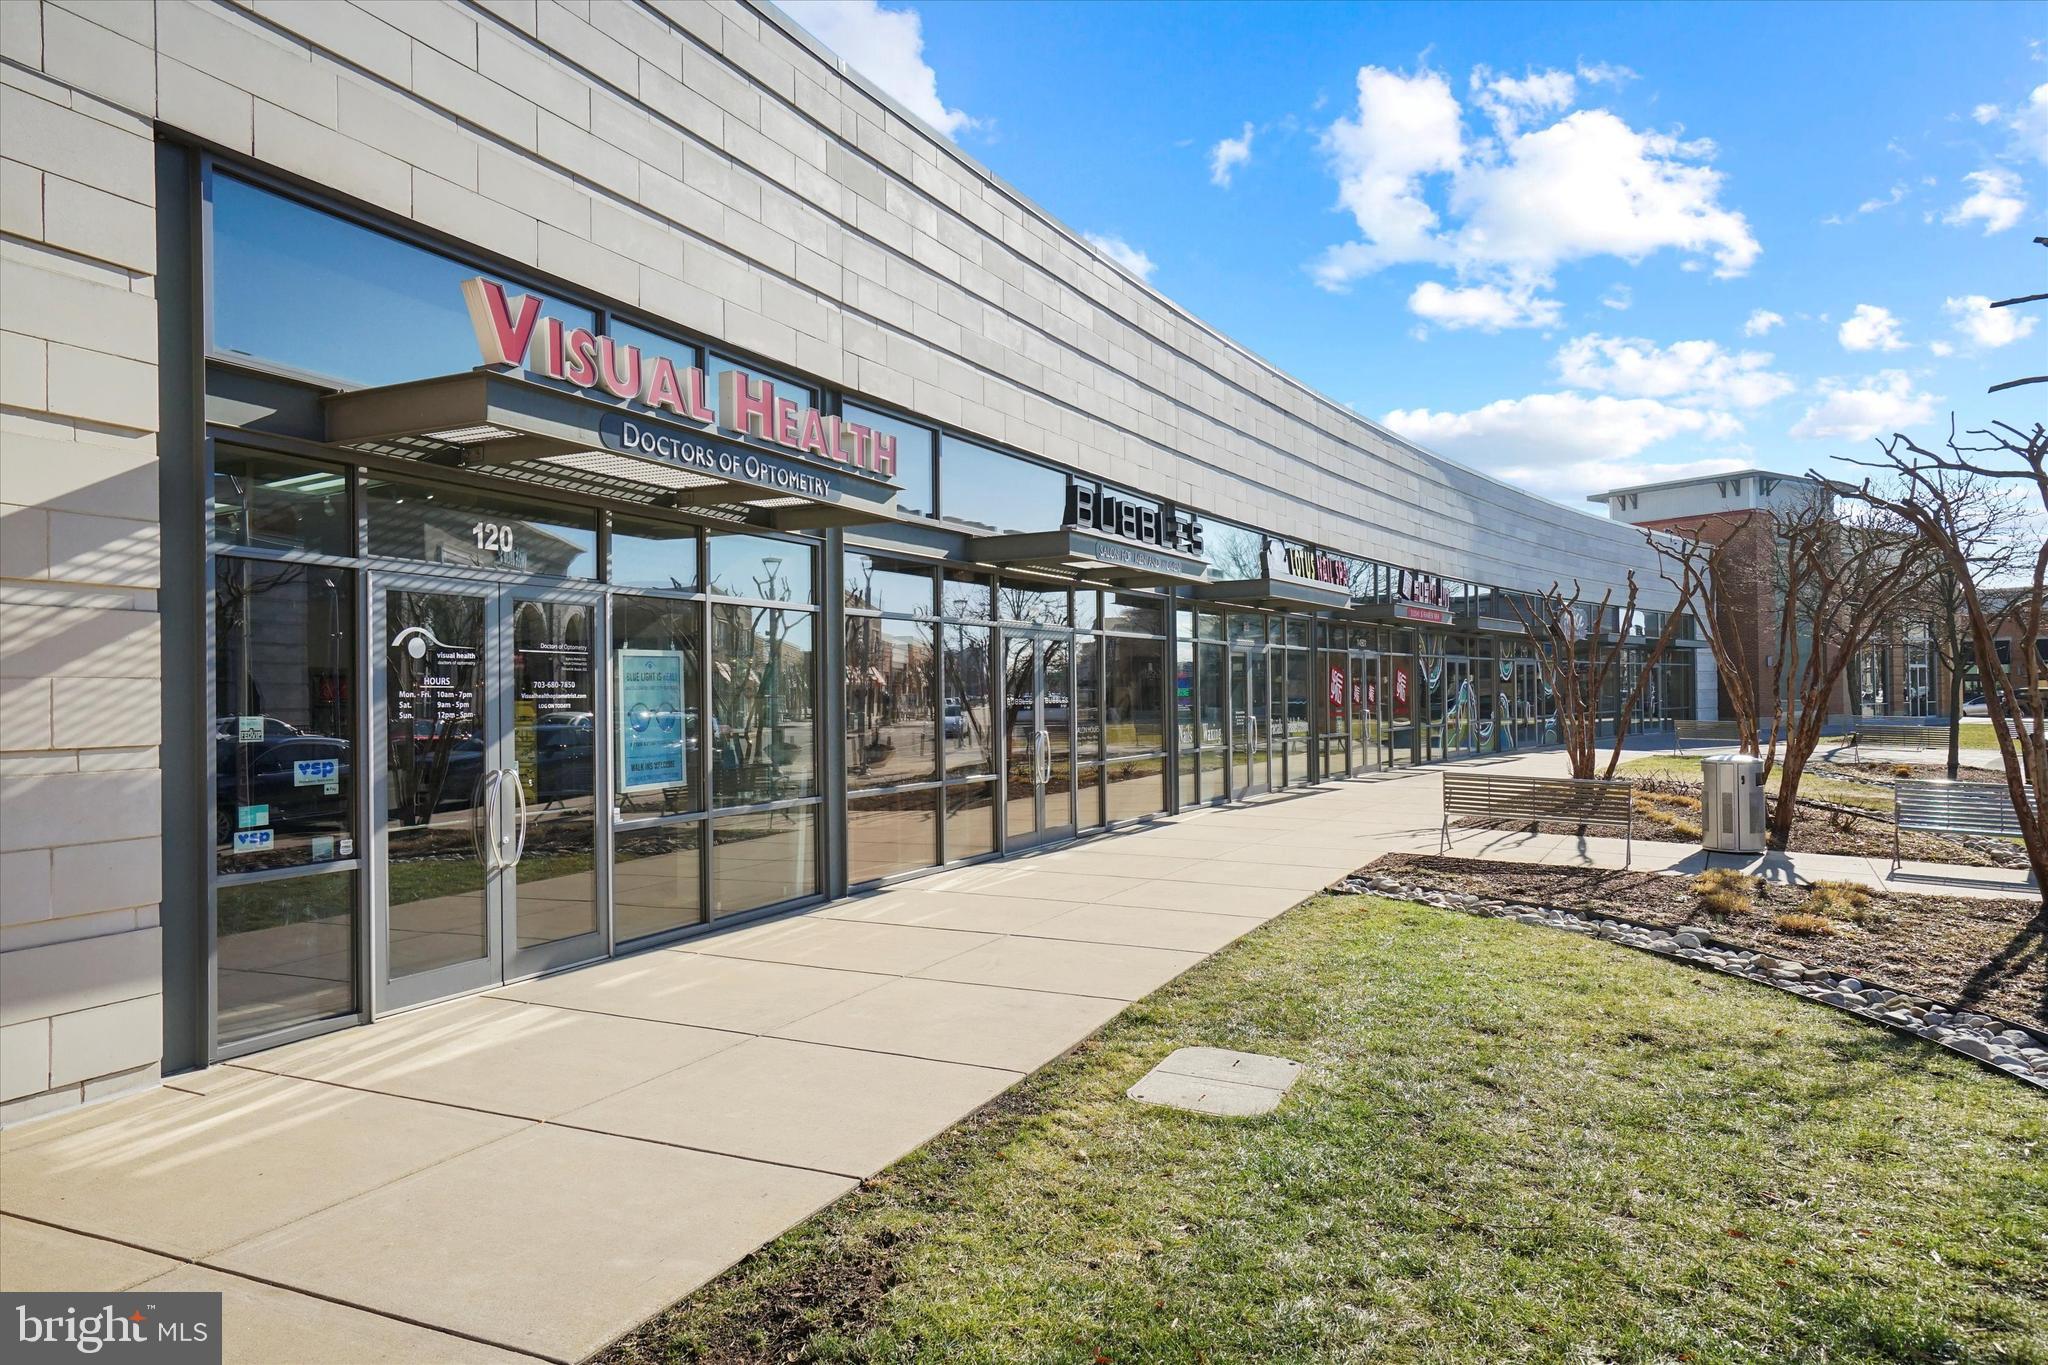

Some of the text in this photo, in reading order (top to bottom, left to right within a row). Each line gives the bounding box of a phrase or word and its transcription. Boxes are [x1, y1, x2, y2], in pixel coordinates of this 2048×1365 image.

[463, 276, 897, 478] VISUAL HEALTH
[623, 421, 831, 496] DOCTORS OF OPTOMETRY
[1066, 485, 1204, 556] BUBBLES
[472, 521, 513, 552] 120
[1288, 548, 1316, 580] LOTUS
[540, 642, 557, 650] Doctors
[424, 677, 451, 685] HOURS
[399, 690, 416, 698] Mon.
[459, 691, 473, 699] 7pm
[399, 701, 412, 709] Sat.
[399, 711, 414, 719] Sun.
[437, 711, 455, 719] 12pm
[298, 761, 335, 778] vsp
[238, 831, 270, 846] vsp
